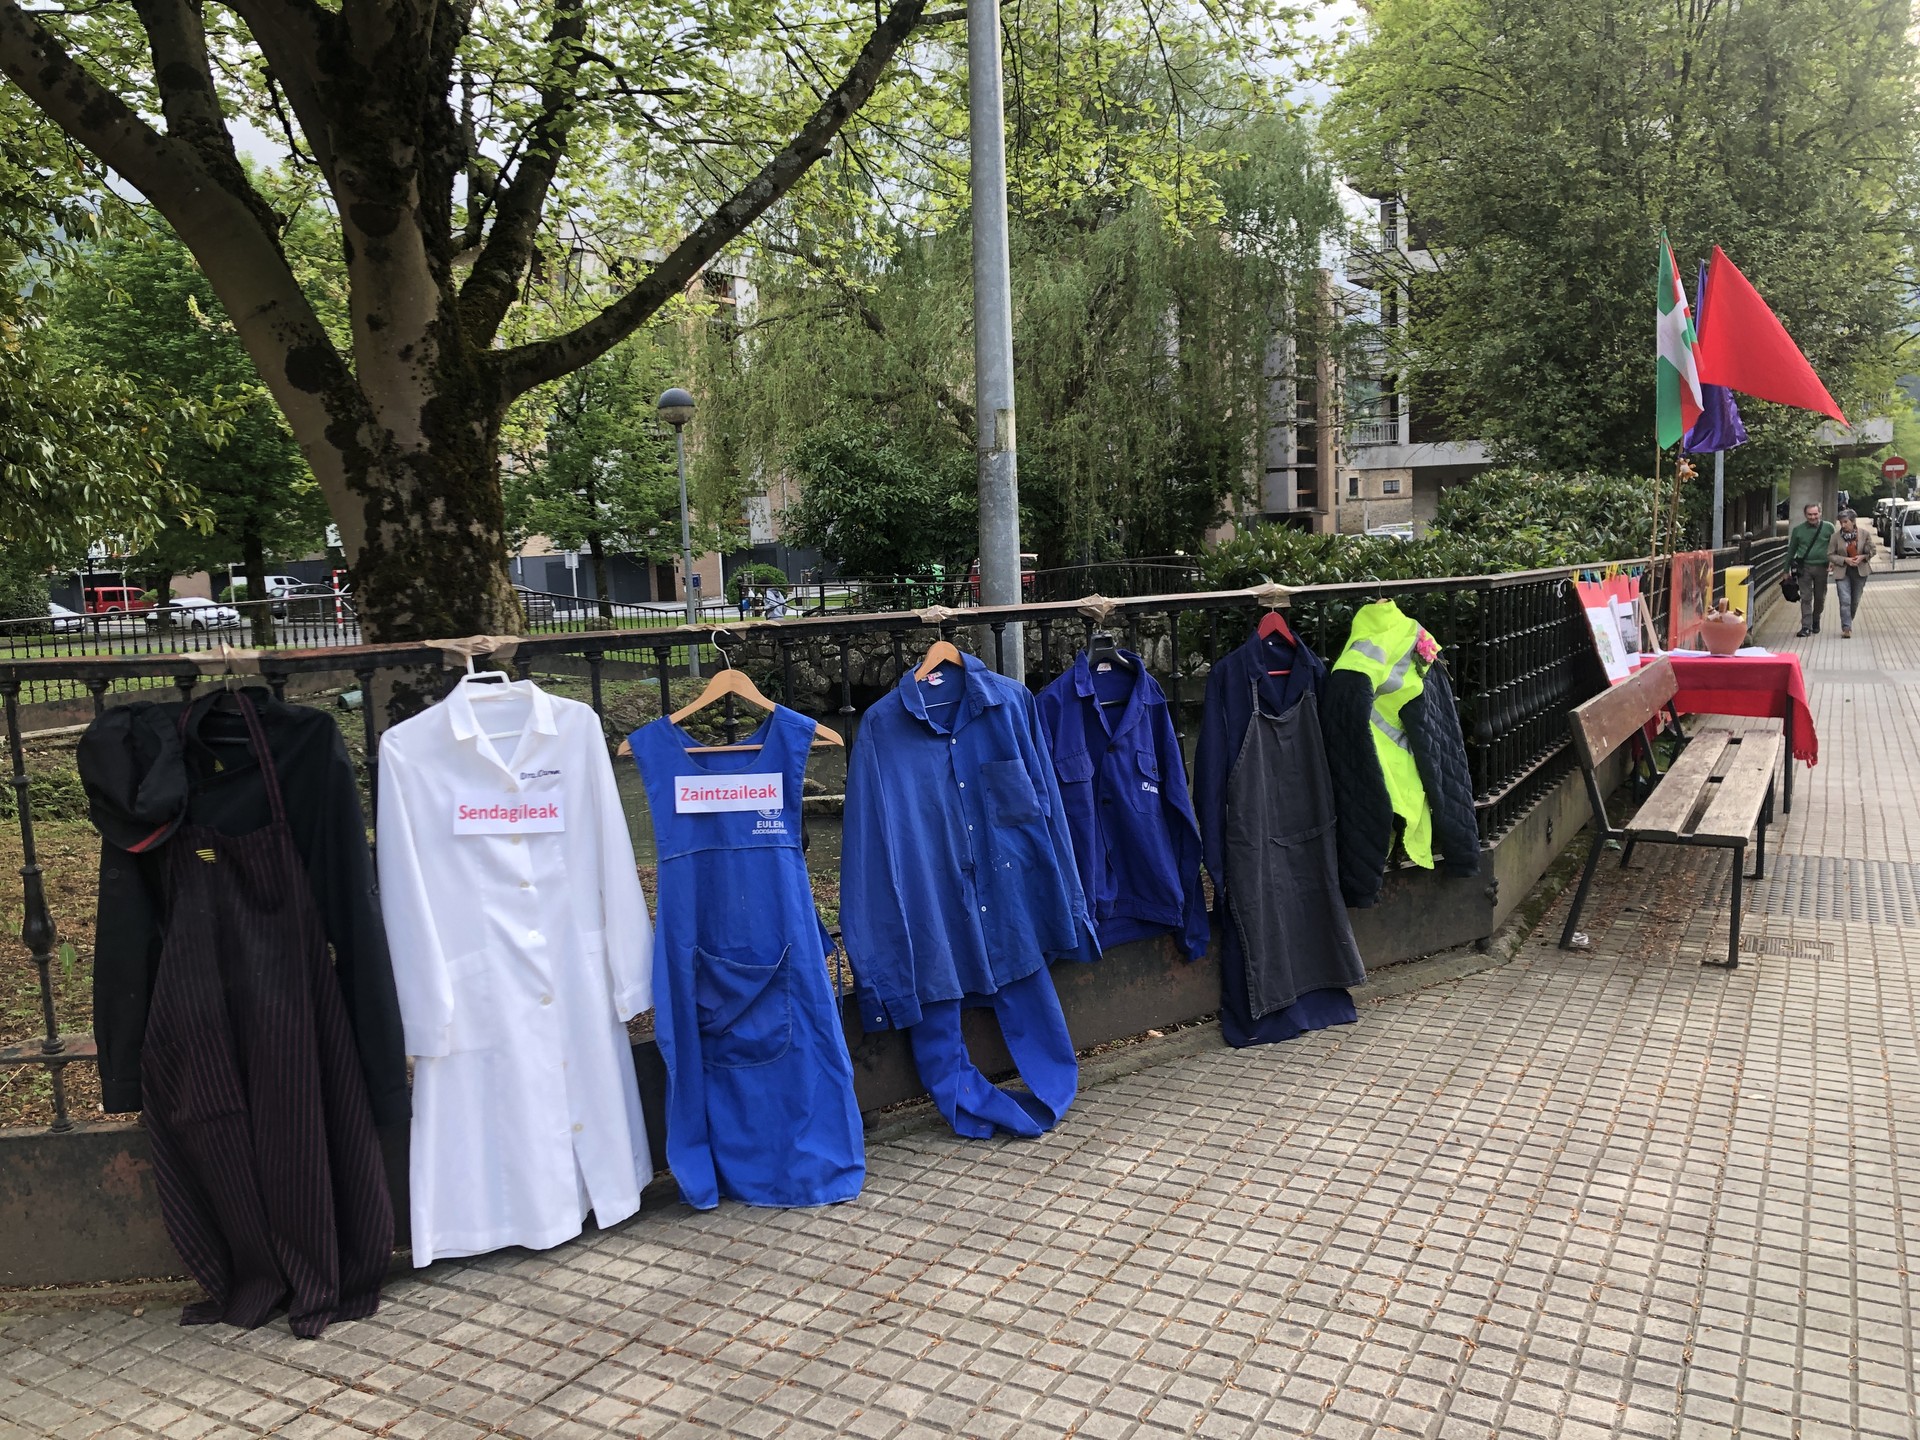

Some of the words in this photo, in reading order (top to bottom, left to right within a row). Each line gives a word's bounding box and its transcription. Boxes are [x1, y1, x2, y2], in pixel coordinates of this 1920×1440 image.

[680, 783, 777, 801] Zaintzaileak
[458, 803, 559, 823] Sendagileak
[756, 820, 784, 828] EULEN
